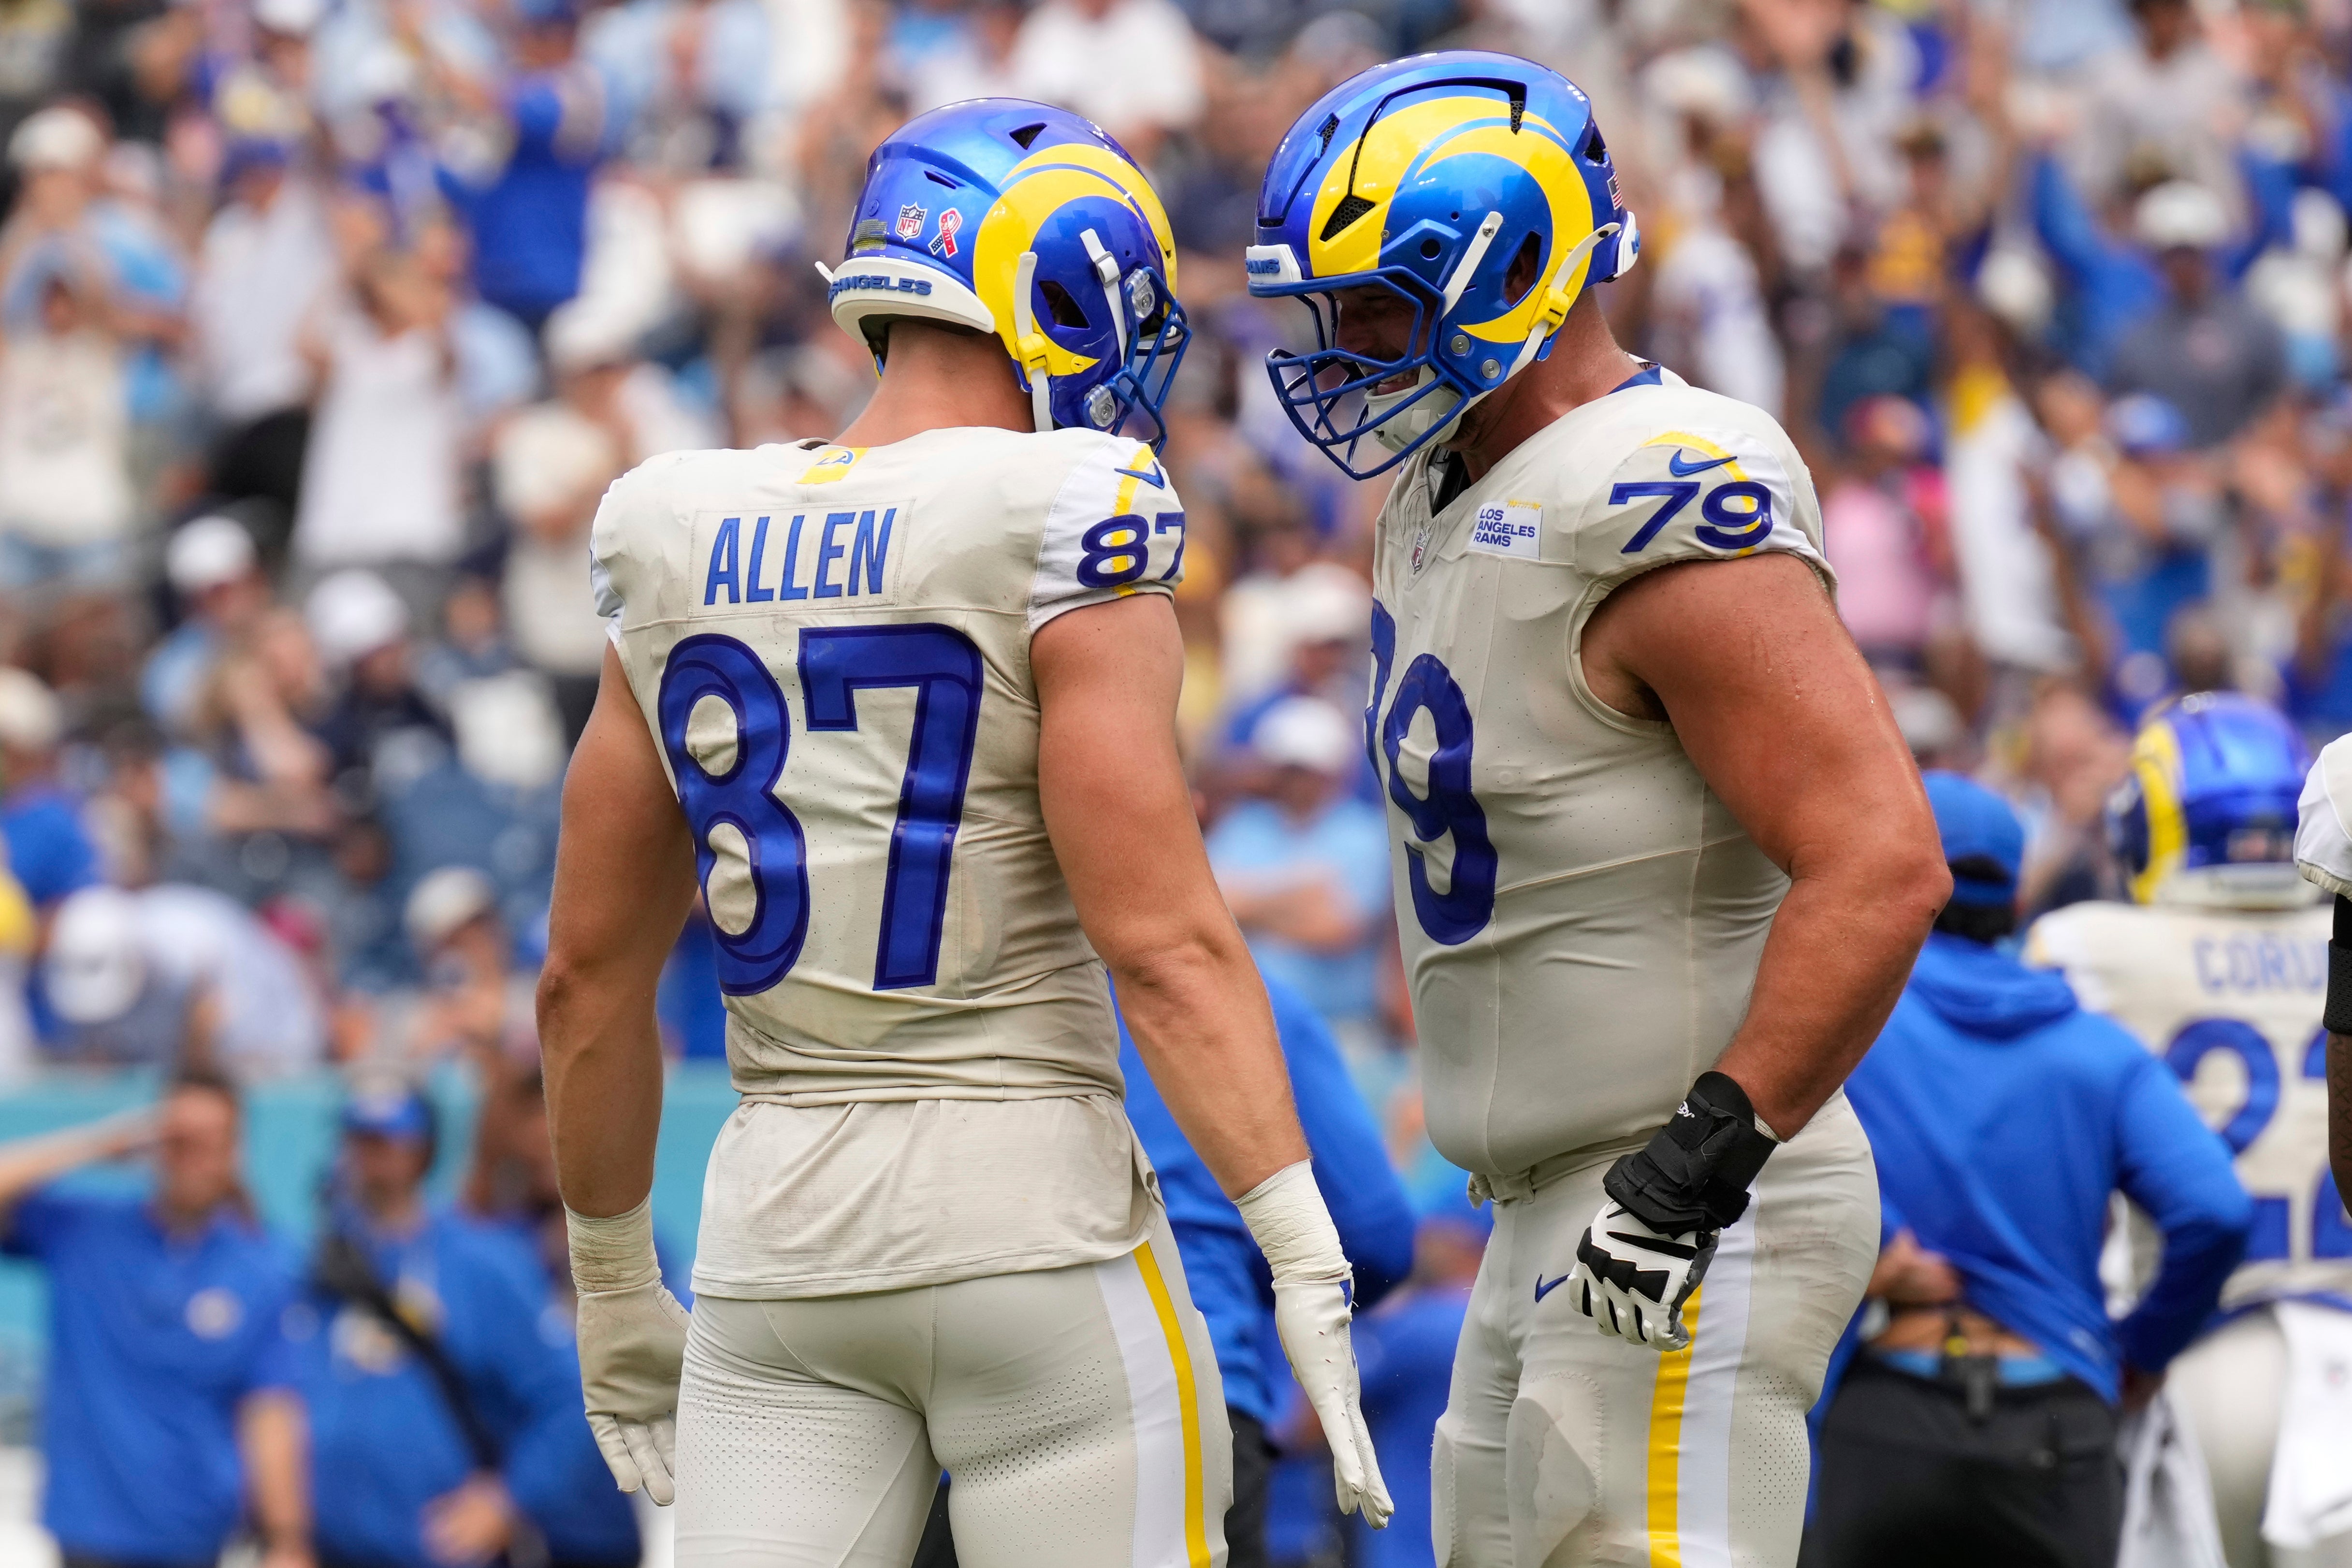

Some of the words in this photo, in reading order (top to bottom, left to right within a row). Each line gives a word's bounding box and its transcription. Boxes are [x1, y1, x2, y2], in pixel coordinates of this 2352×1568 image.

[899, 218, 917, 234] NFL
[1473, 532, 1511, 547] RAMS
[1477, 520, 1536, 538] ANGELES
[1479, 508, 1504, 521] LOS
[1608, 481, 1773, 553] 79
[704, 508, 897, 606] ALLEN
[1076, 512, 1186, 589] 87
[657, 622, 984, 997] 87
[2192, 931, 2329, 993] CORU
